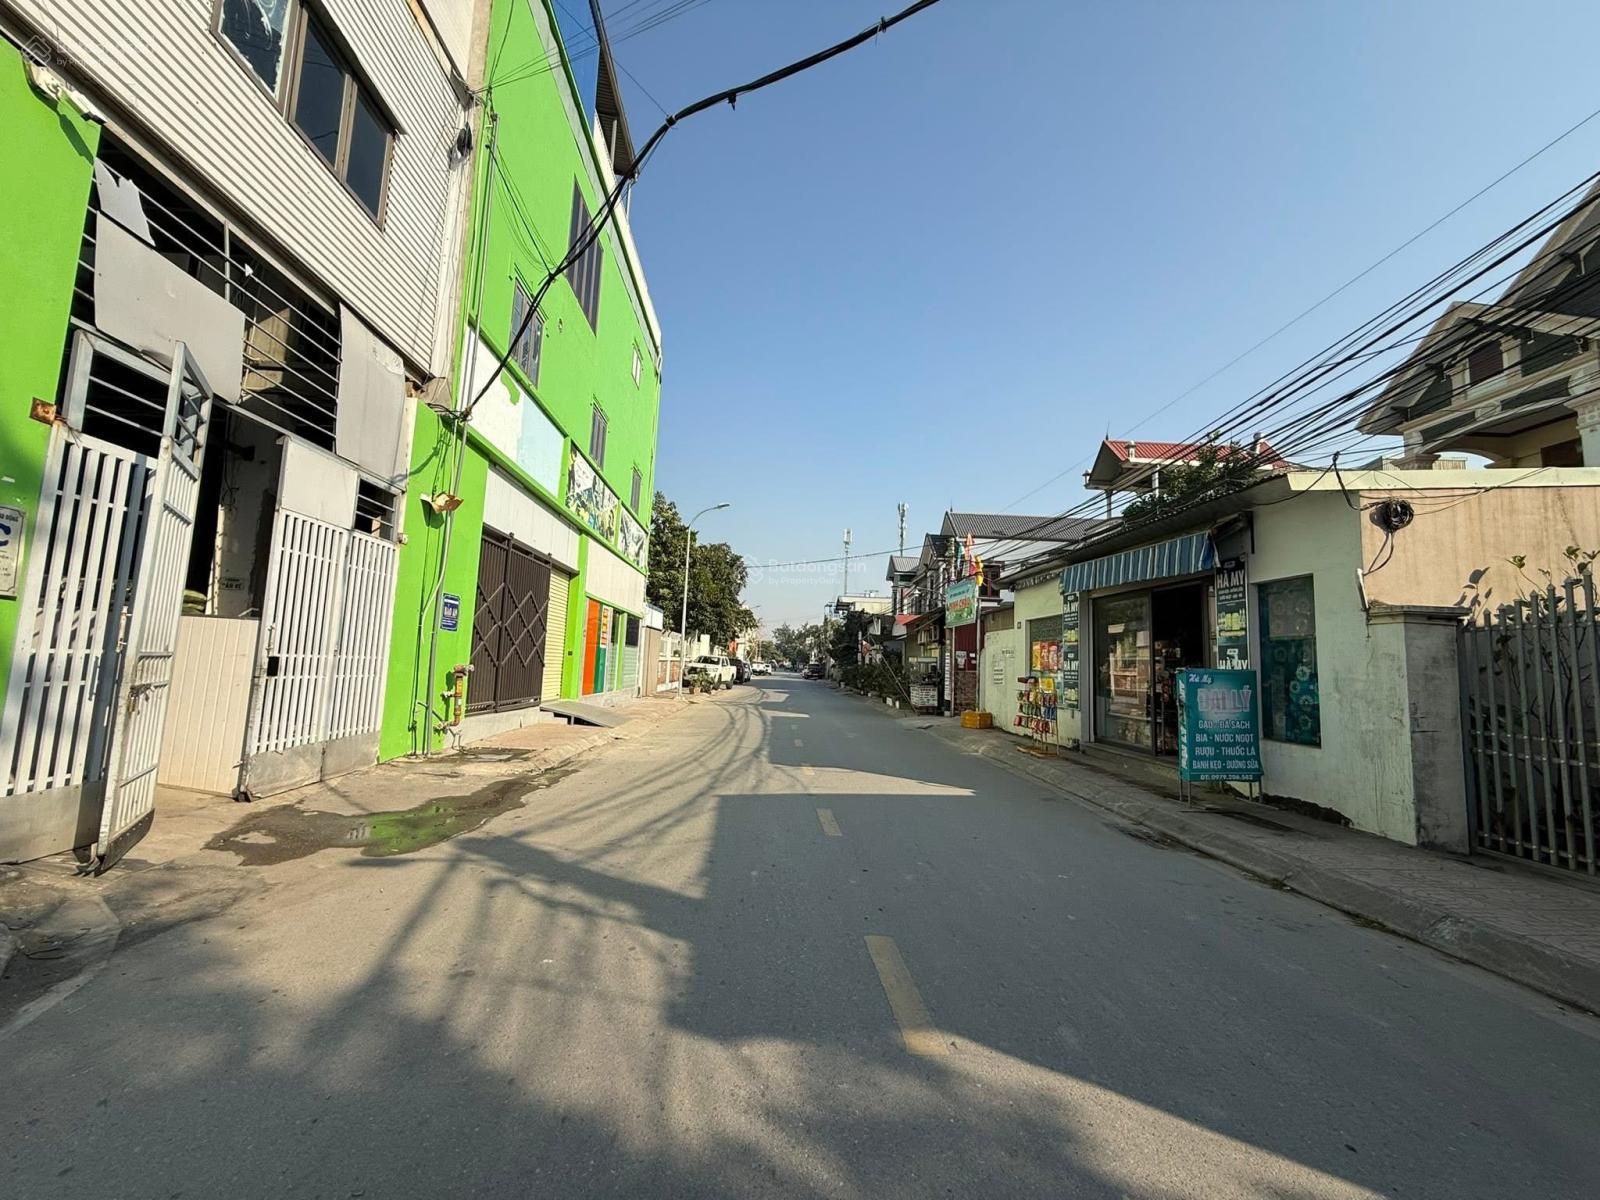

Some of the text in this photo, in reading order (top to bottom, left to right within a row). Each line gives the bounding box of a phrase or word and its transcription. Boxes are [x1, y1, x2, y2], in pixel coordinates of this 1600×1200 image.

[1230, 569, 1245, 587] MY
[1195, 733, 1208, 742] BIA
[1221, 744, 1245, 756] THUỐC
